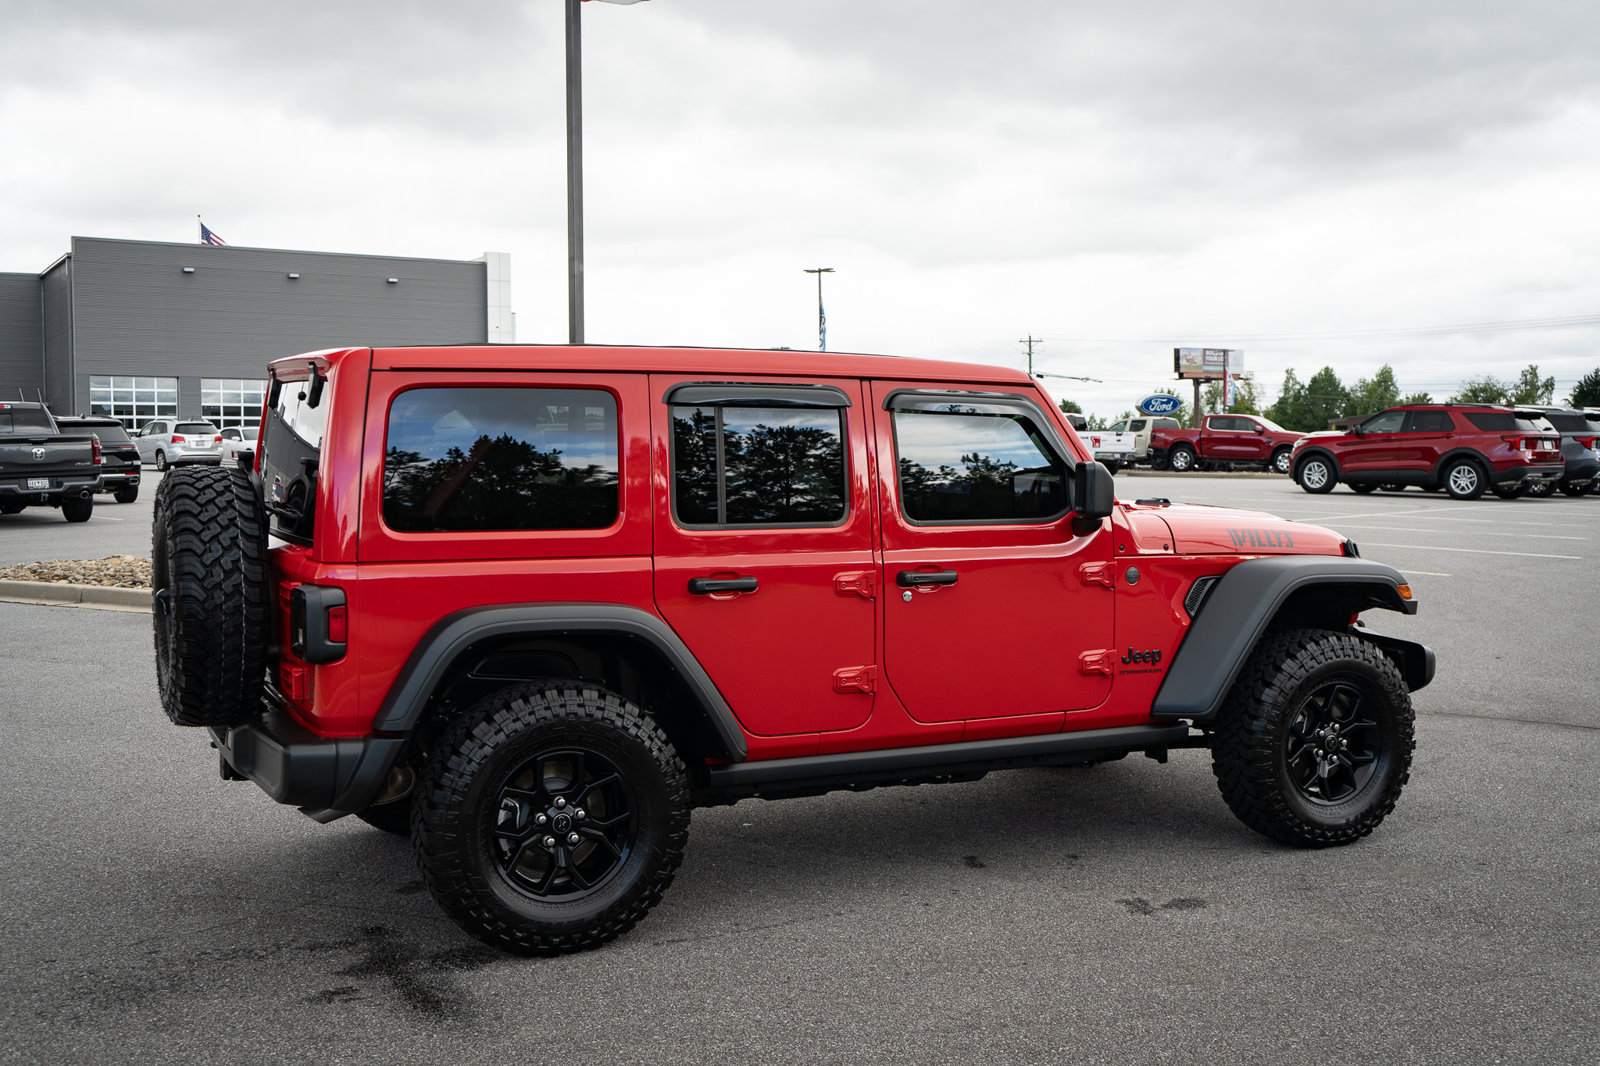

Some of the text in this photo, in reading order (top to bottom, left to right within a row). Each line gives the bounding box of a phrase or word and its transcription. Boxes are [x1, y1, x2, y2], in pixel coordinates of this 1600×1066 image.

[1149, 398, 1173, 411] Ford
[1226, 528, 1294, 548] WILLYS
[1121, 646, 1162, 666] Jeep
